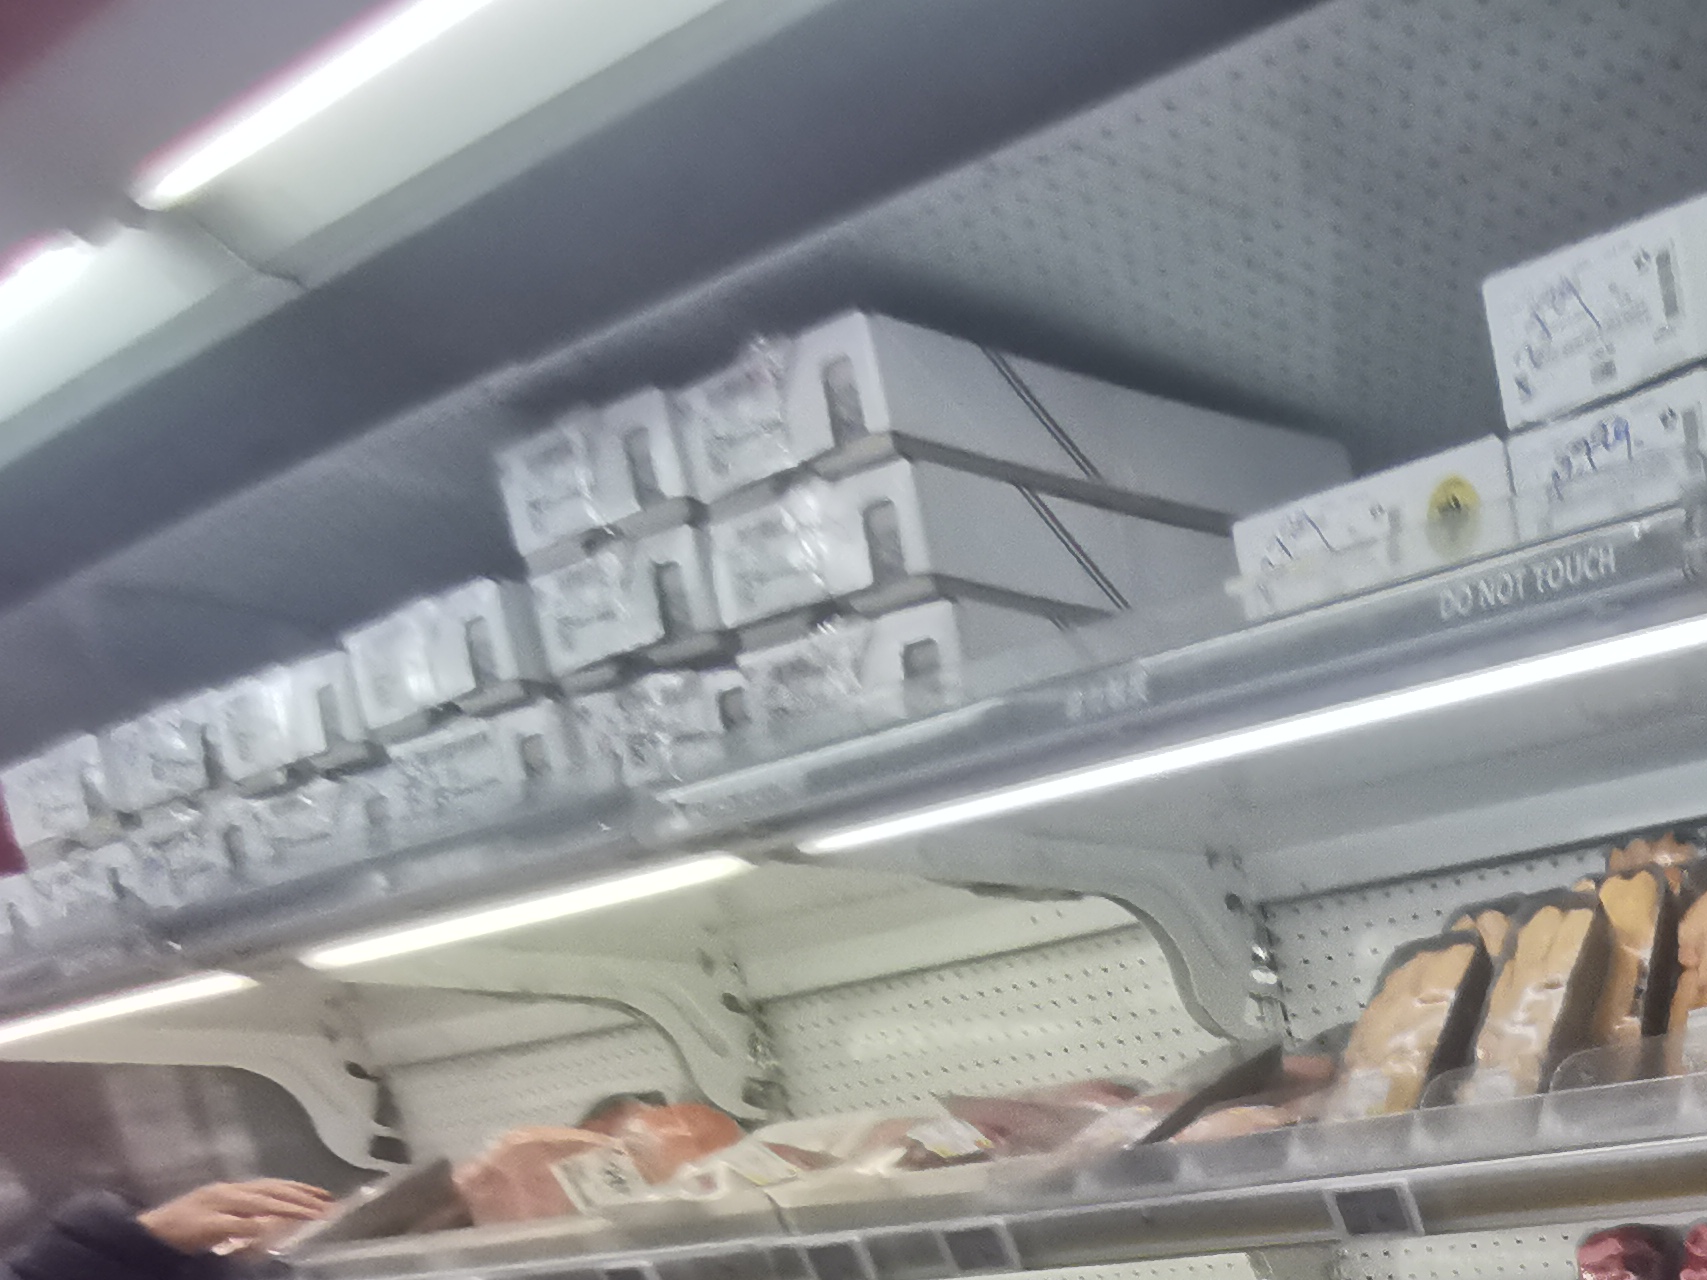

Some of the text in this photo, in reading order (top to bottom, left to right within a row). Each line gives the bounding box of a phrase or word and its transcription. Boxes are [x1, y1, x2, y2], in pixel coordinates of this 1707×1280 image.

[1439, 543, 1616, 620] DO NOT TOUCH
